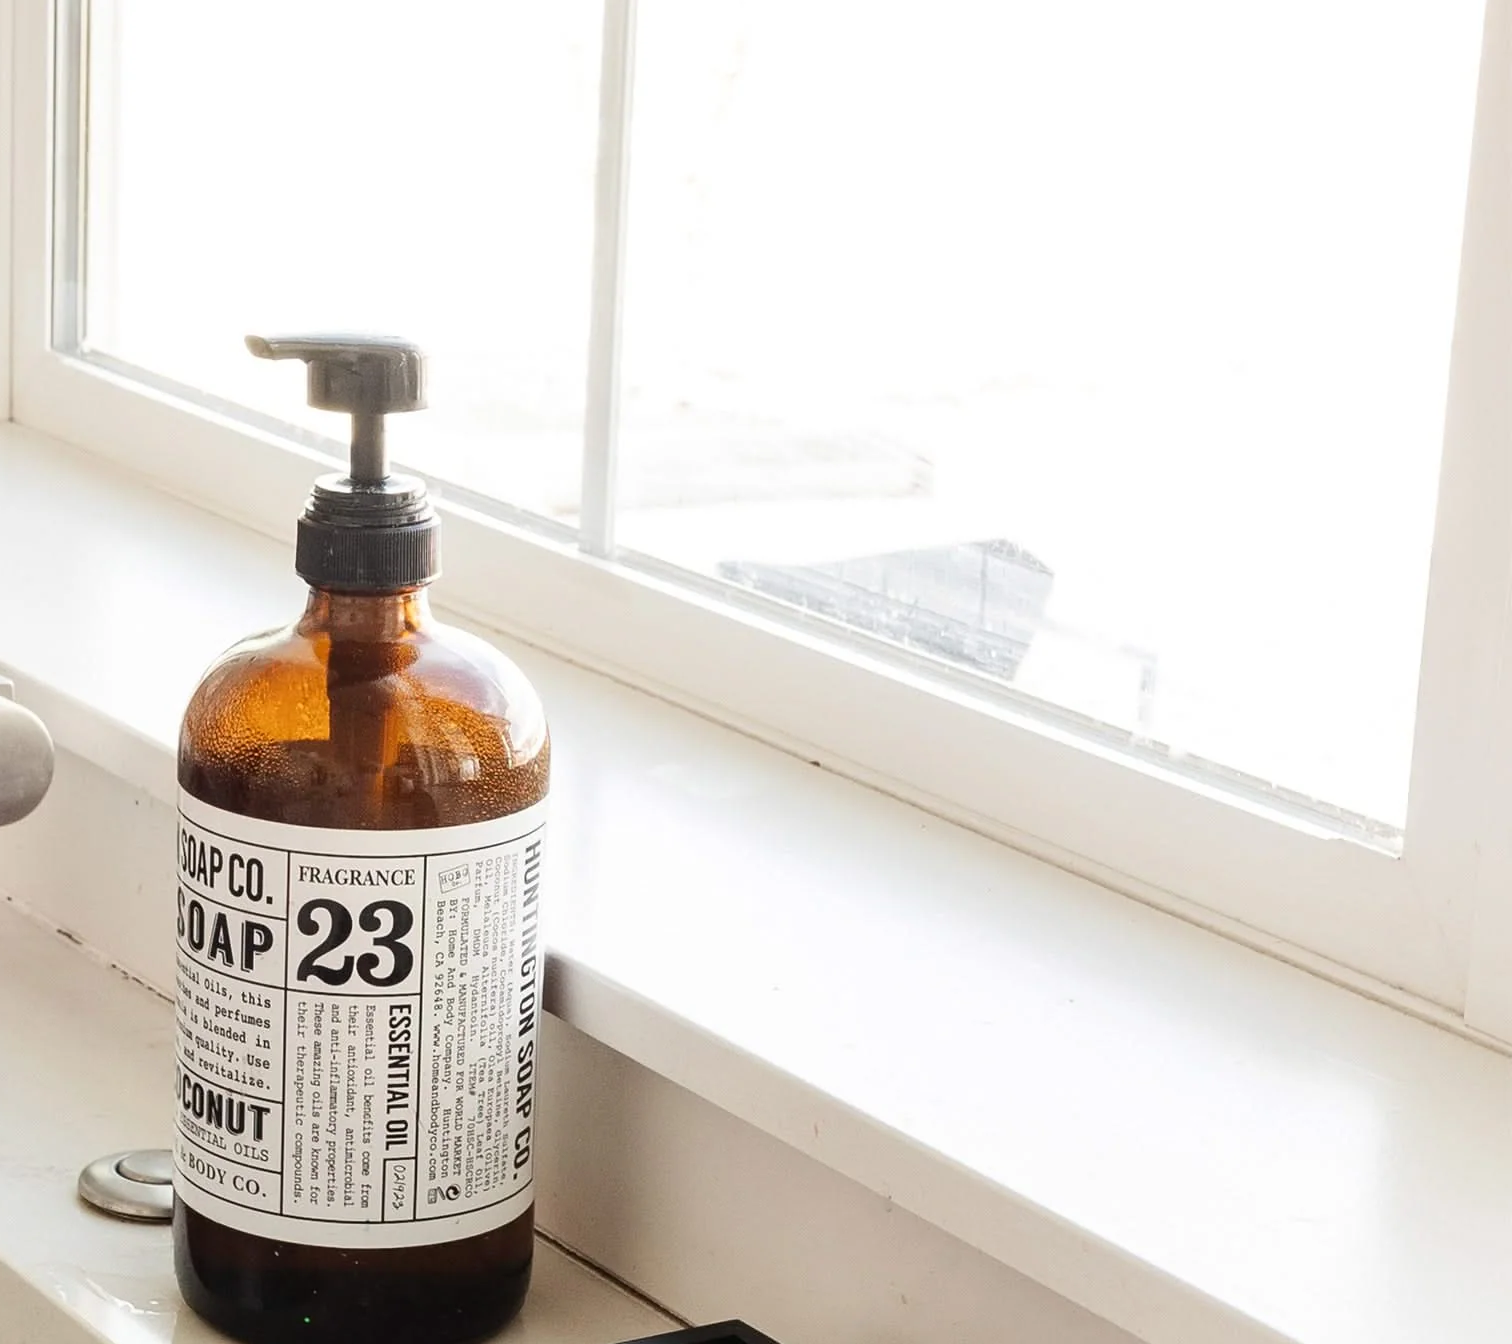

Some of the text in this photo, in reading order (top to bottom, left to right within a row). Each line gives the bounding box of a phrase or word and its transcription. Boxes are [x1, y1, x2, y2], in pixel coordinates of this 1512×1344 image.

[181, 827, 223, 889] SOAP
[229, 853, 273, 905] CO.
[298, 865, 416, 887] FRAGRANCE
[177, 886, 274, 973] SOAP
[434, 901, 446, 944] Beach,
[449, 899, 457, 919] BY:
[297, 898, 414, 987] 23
[448, 930, 457, 957] Home
[459, 897, 470, 966] FORMULATED
[435, 952, 443, 967] CA
[447, 968, 456, 988] And
[195, 995, 210, 1010] and
[214, 1004, 271, 1029] perfumes
[204, 978, 232, 1001] Oils,
[241, 991, 271, 1008] this
[433, 974, 444, 1017] 92648.
[444, 998, 455, 1025] Body
[513, 840, 541, 1180] HUNTINGTON SOAP CO.
[190, 1009, 198, 1024] is
[203, 1016, 246, 1043] blended
[255, 1034, 271, 1049] in
[456, 984, 467, 1065] MANUFACTURED
[195, 1036, 239, 1063] quality.
[247, 1053, 270, 1069] Use
[199, 1056, 270, 1090] revitalize.
[443, 1035, 454, 1090] Company.
[385, 1004, 412, 1150] ESSENTIAL OIL
[455, 1072, 464, 1091] FOR
[176, 1064, 271, 1142] OCONUT
[292, 1002, 308, 1204] their therapeutic compounds.
[309, 1003, 324, 1205] These amazing oils are known for
[324, 1003, 341, 1207] and anti-inflammatory properties.
[343, 1005, 358, 1207] their antioxidant, antimicrobial
[360, 1005, 376, 1208] Essential oil benefits come from
[428, 1025, 442, 1181] www.homeandbodyco.com
[454, 1096, 463, 1131] WORLD
[234, 1142, 269, 1162] OILS
[440, 1109, 451, 1178] Huntington
[453, 1136, 462, 1176] MARKET
[189, 1152, 227, 1185] BODY
[233, 1175, 267, 1197] CO.
